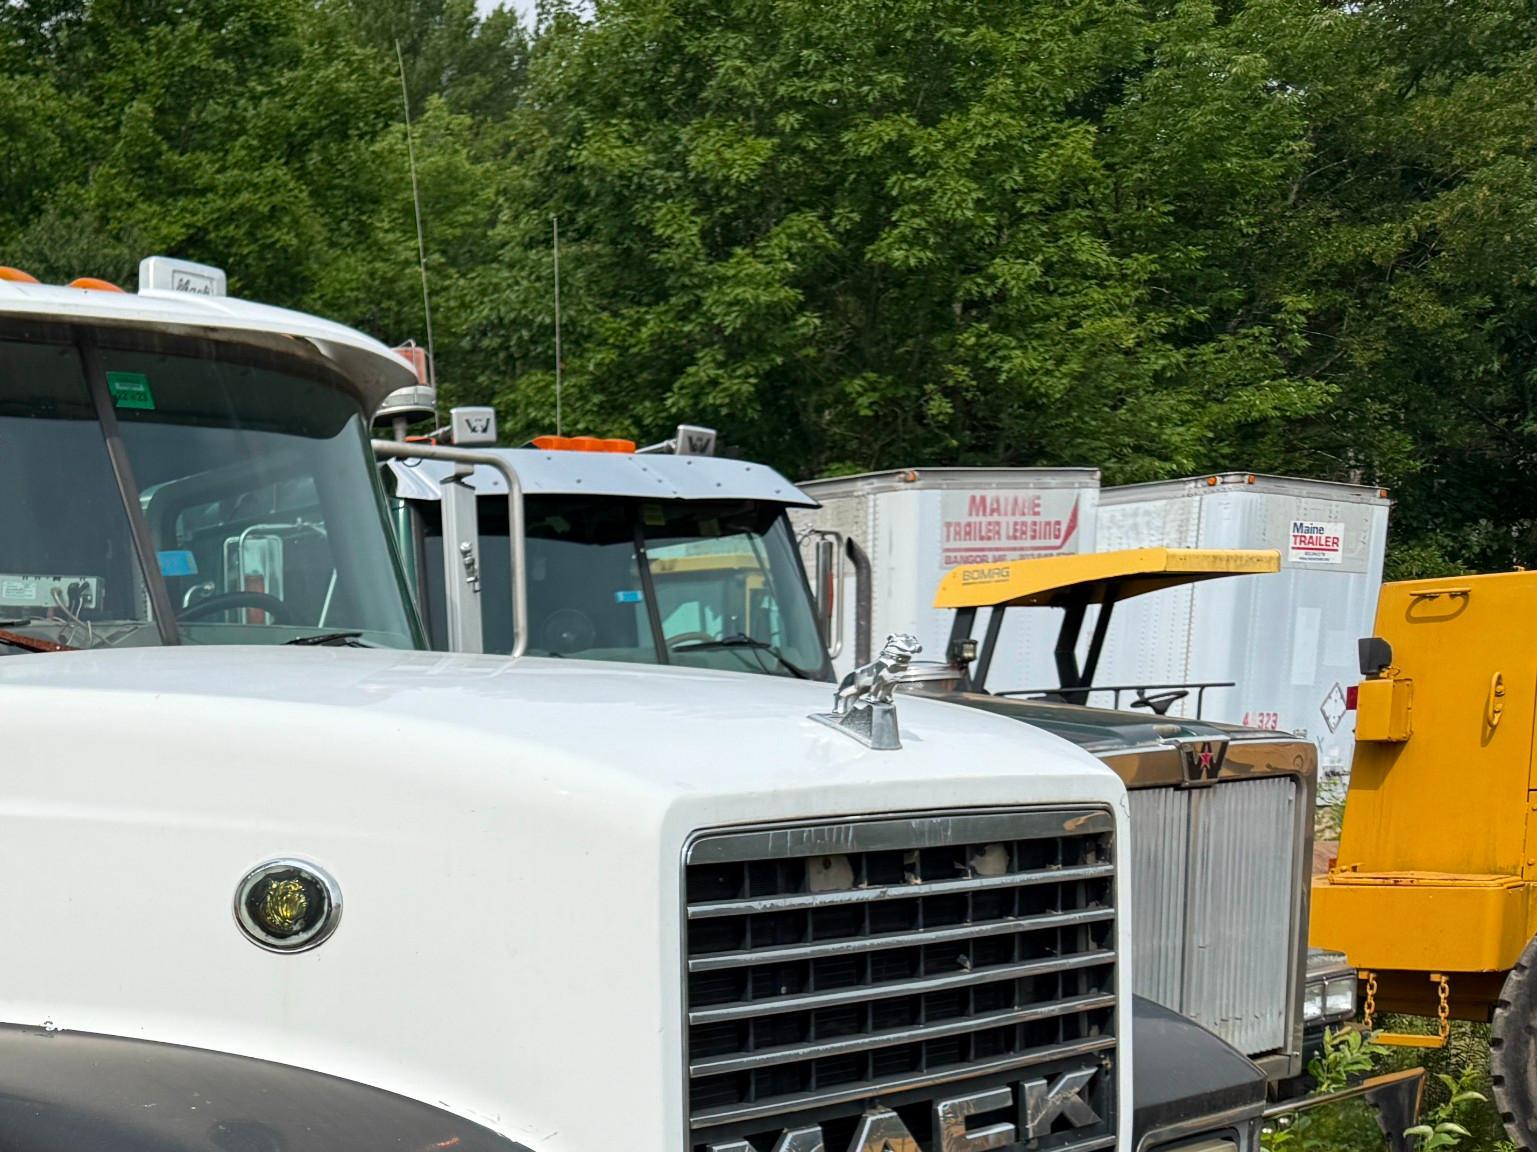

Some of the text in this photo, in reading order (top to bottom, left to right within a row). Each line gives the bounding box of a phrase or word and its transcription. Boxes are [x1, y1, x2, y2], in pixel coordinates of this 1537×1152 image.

[968, 494, 1041, 517] MAINE
[944, 519, 1062, 542] TRAILER LEASING
[1292, 522, 1325, 535] Maine
[1292, 534, 1340, 548] TRAILER
[962, 567, 1010, 581] BOMAG
